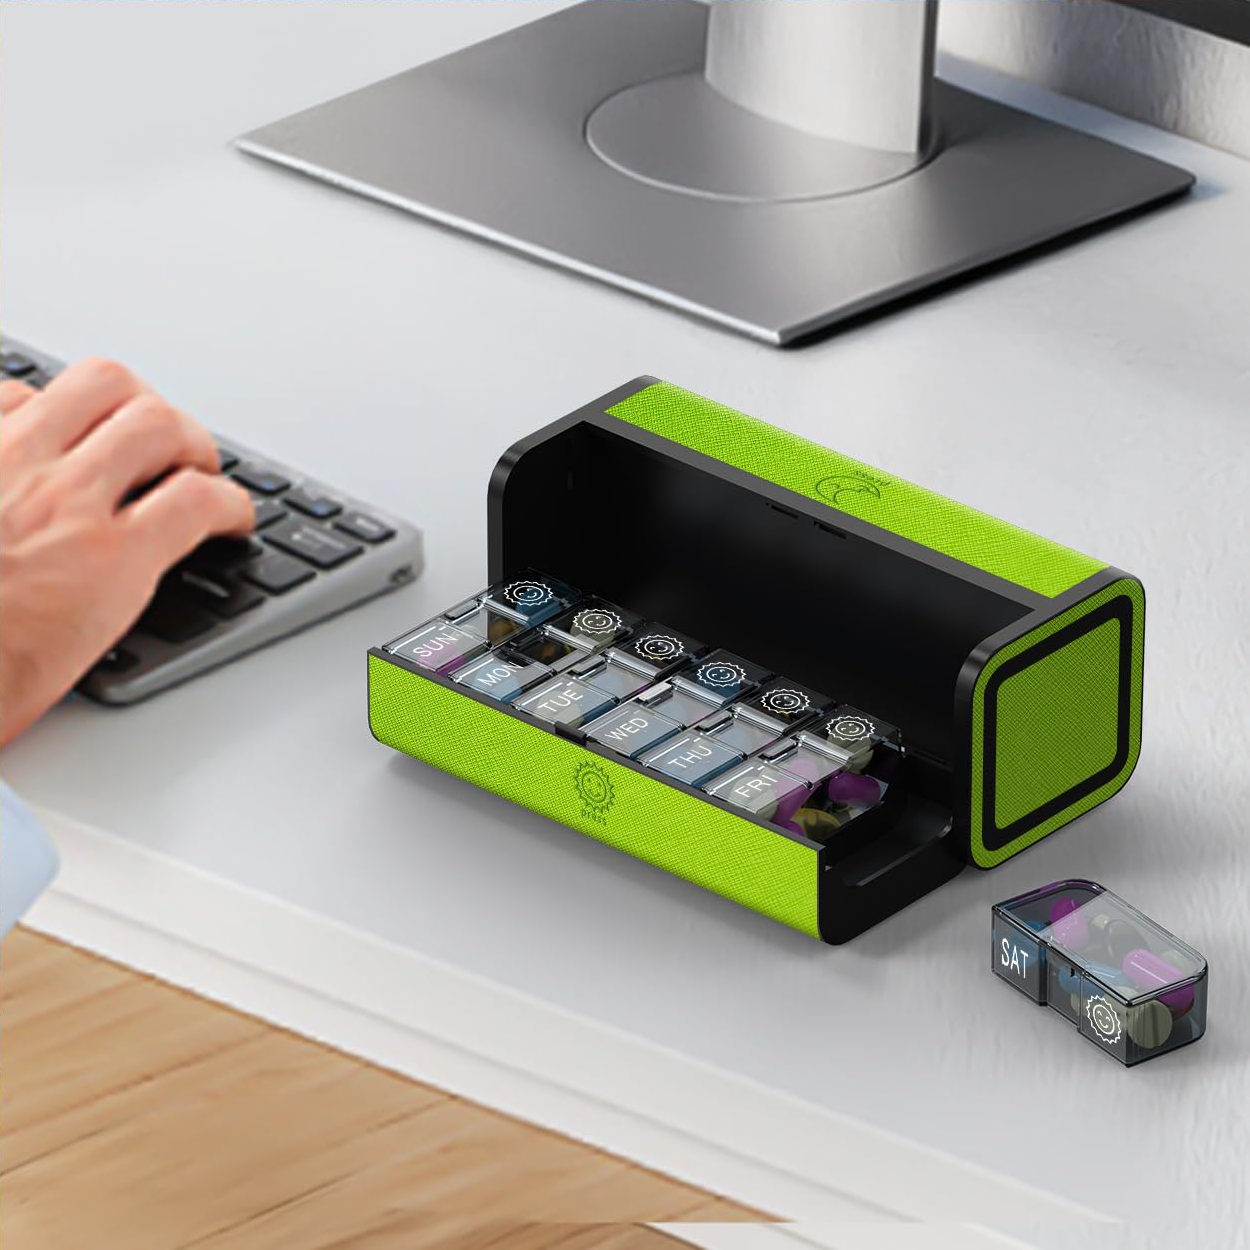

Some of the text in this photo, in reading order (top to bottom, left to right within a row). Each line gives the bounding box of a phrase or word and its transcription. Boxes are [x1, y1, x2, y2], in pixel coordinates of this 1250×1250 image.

[412, 632, 459, 657] SUN
[477, 661, 523, 686] MON
[537, 688, 584, 712] TUE
[605, 717, 648, 740] WED
[667, 745, 712, 768] THU
[734, 774, 778, 798] FRI
[1001, 938, 1029, 979] SAT
